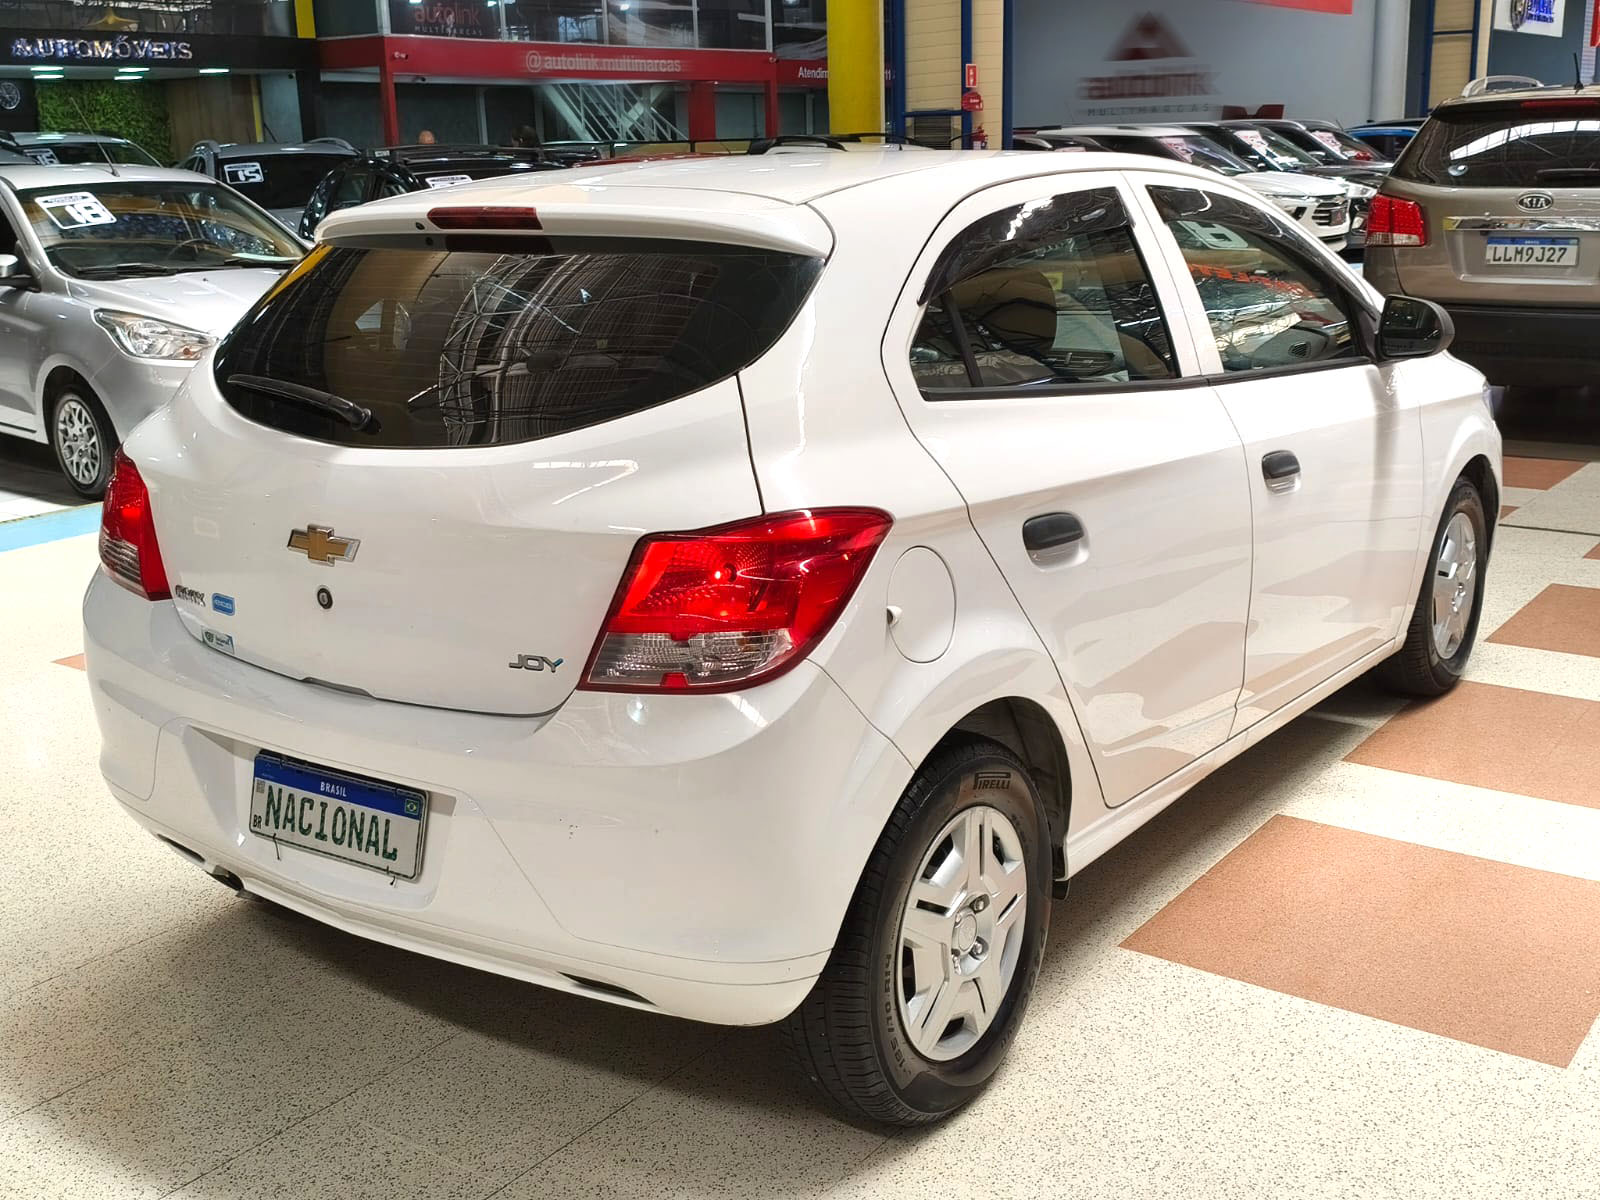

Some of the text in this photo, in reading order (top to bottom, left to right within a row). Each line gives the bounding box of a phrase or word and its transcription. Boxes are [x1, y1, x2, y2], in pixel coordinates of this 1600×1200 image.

[12, 35, 193, 60] AUTOMÓVEIS
[237, 169, 262, 182] 15
[1522, 198, 1547, 208] KIA
[64, 203, 114, 224] 18
[1492, 246, 1568, 263] LLM9J27
[508, 653, 564, 673] JOY
[319, 780, 348, 798] BRASIL
[973, 771, 1011, 790] PIRELLI
[252, 814, 262, 829] BR
[264, 784, 398, 862] NACIONAL
